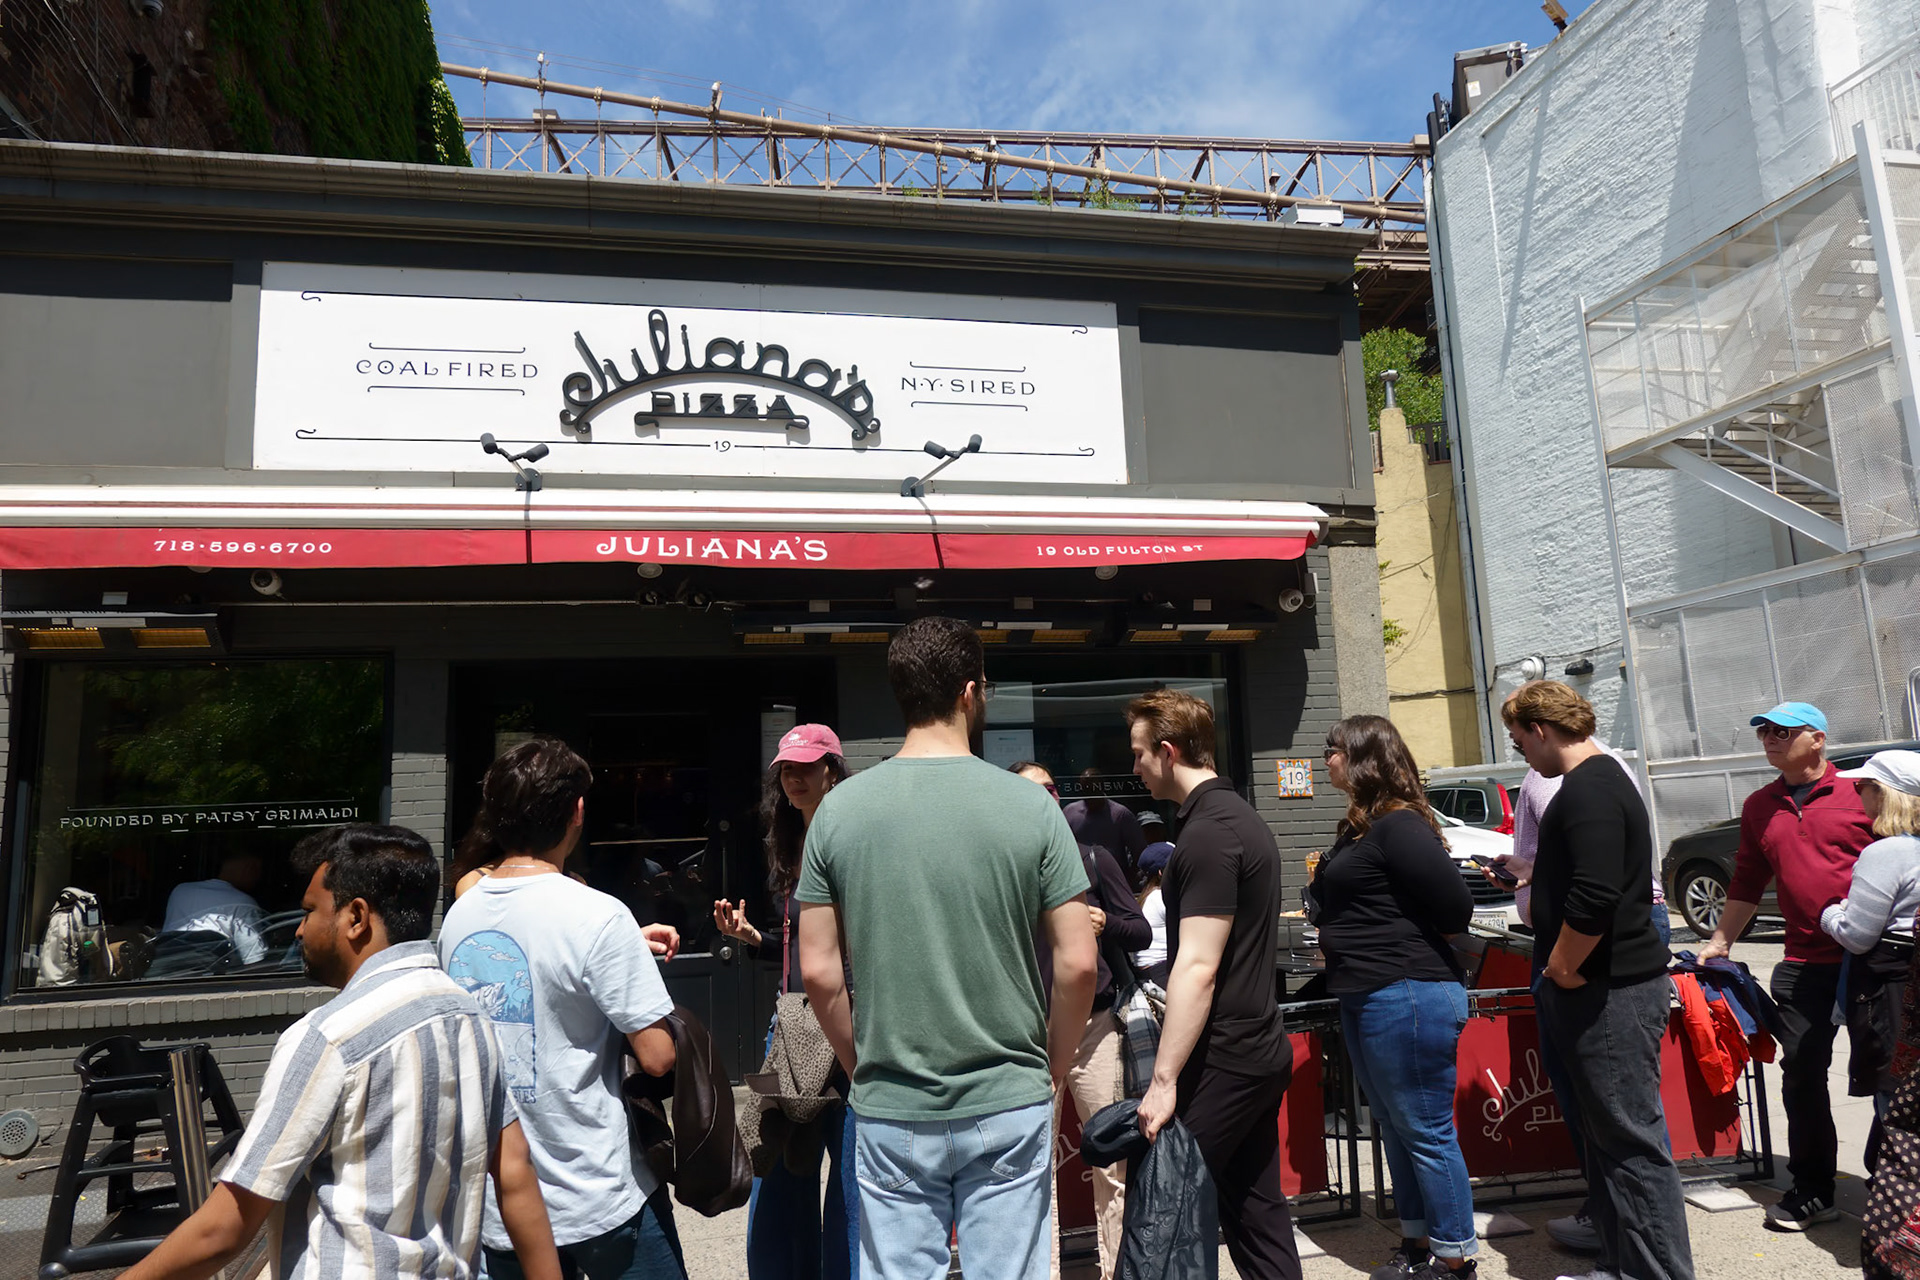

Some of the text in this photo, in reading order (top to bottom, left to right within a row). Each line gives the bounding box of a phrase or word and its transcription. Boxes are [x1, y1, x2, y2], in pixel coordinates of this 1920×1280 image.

[356, 359, 538, 379] COAL FIRED
[648, 391, 798, 419] PIZZA
[713, 440, 732, 453] 19
[596, 536, 828, 561] JULIANA'S
[1037, 546, 1057, 556] 19
[1063, 546, 1100, 556] OLD
[1105, 545, 1177, 555] FULTON
[1289, 771, 1304, 785] 19
[60, 807, 359, 829] FOUNDED BY PATSY GRIMALDI
